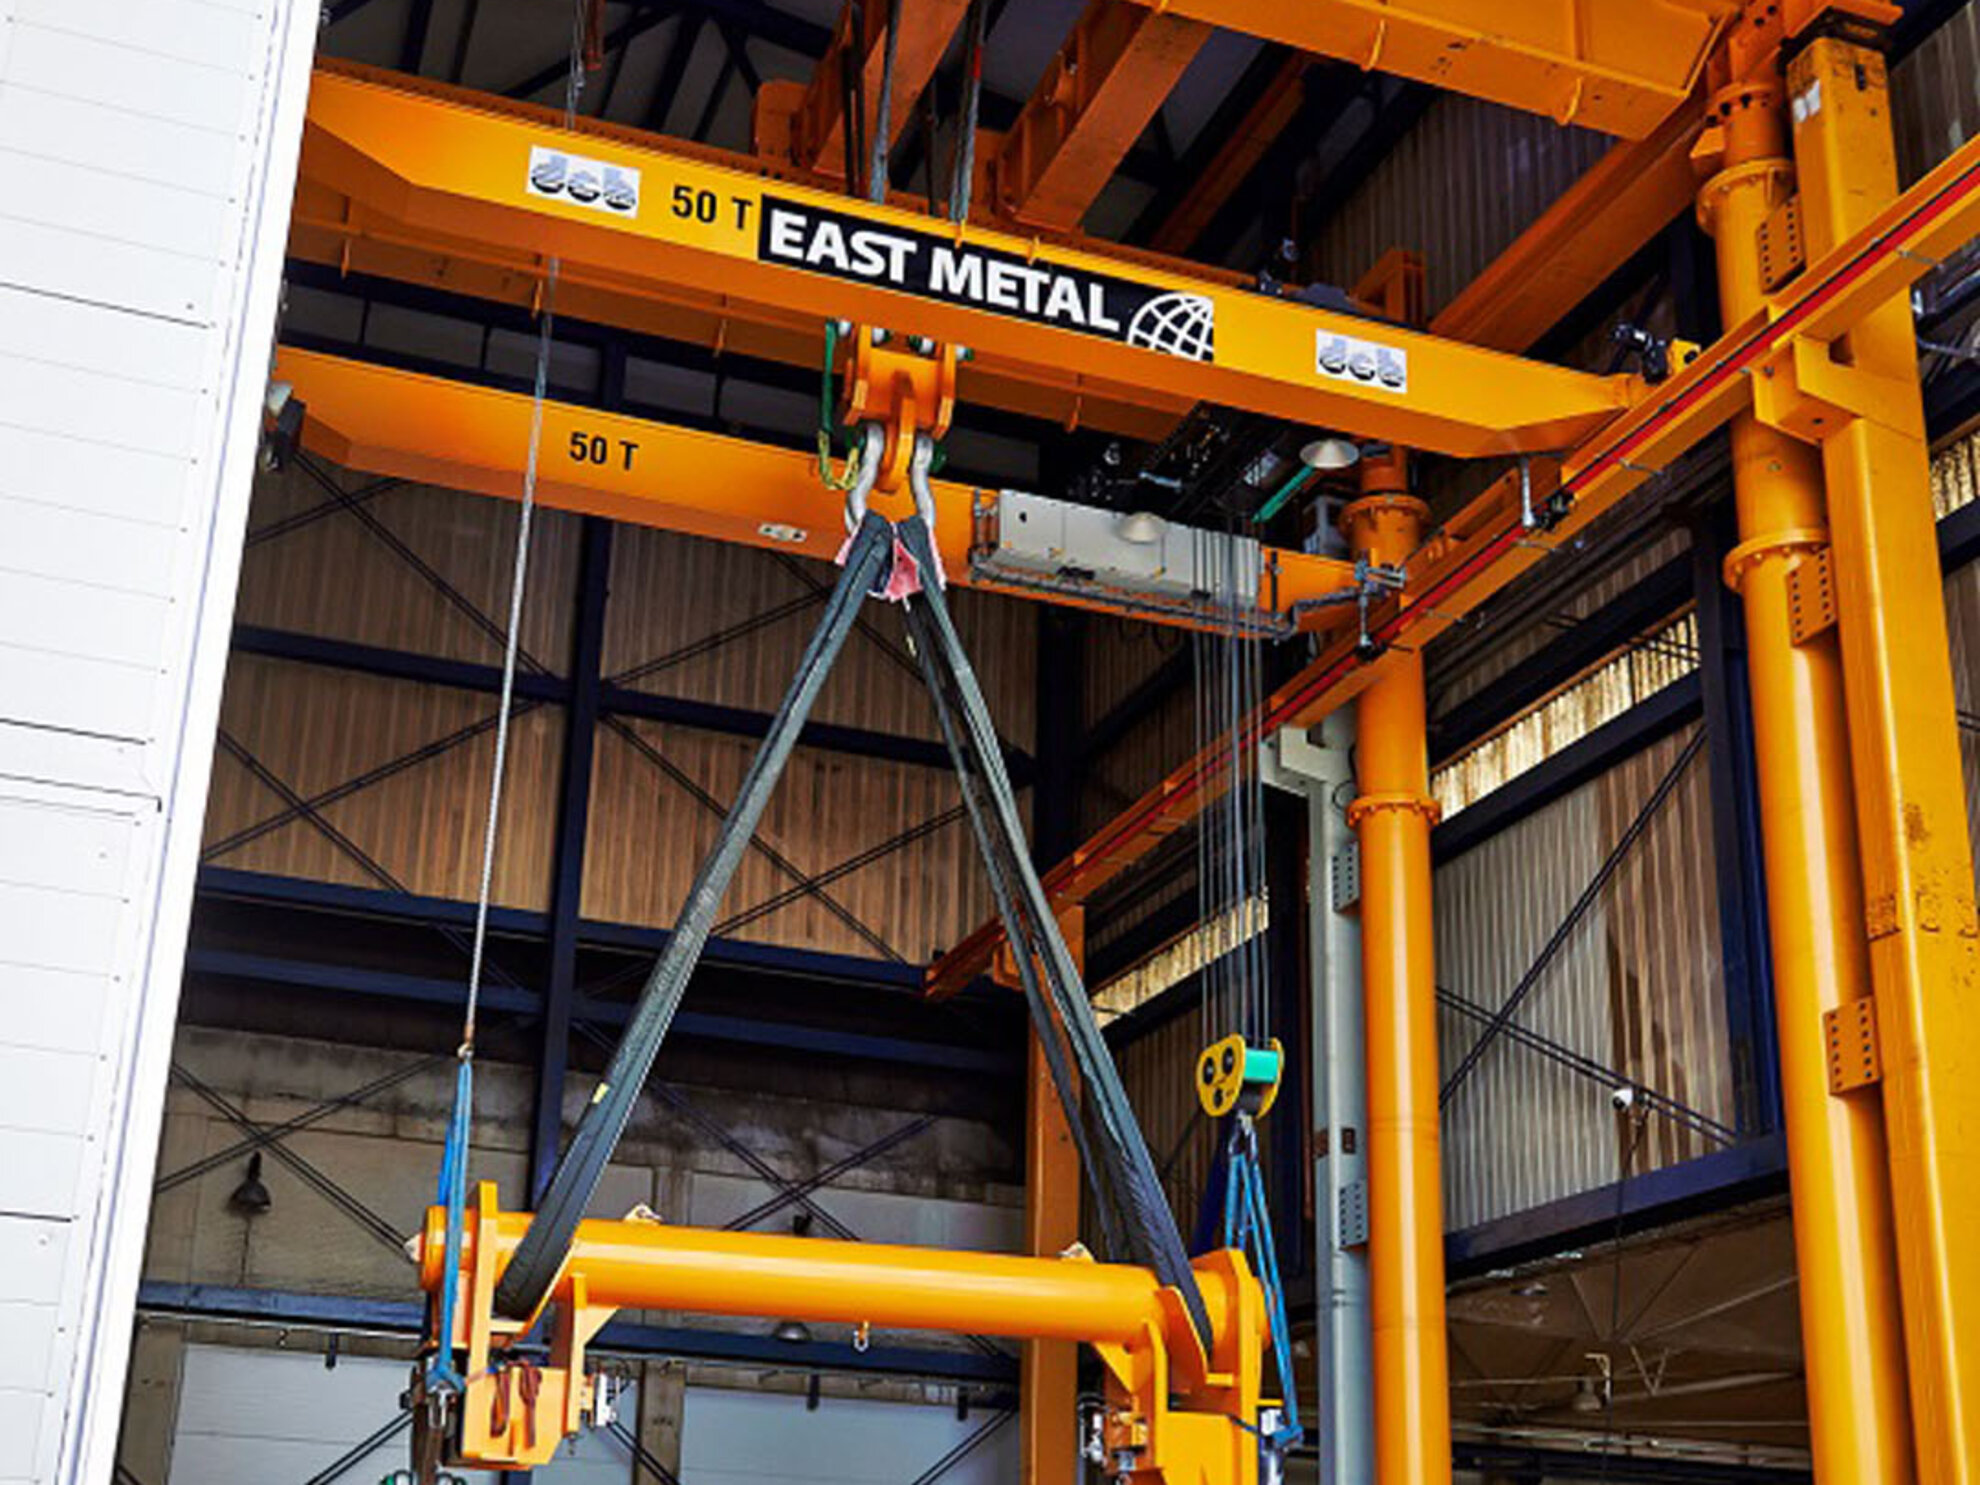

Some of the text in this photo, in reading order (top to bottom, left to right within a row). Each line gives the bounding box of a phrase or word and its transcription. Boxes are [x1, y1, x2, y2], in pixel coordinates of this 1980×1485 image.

[671, 184, 753, 230] 50 T
[769, 208, 1121, 333] EAST METAL
[568, 431, 640, 471] 50 T
